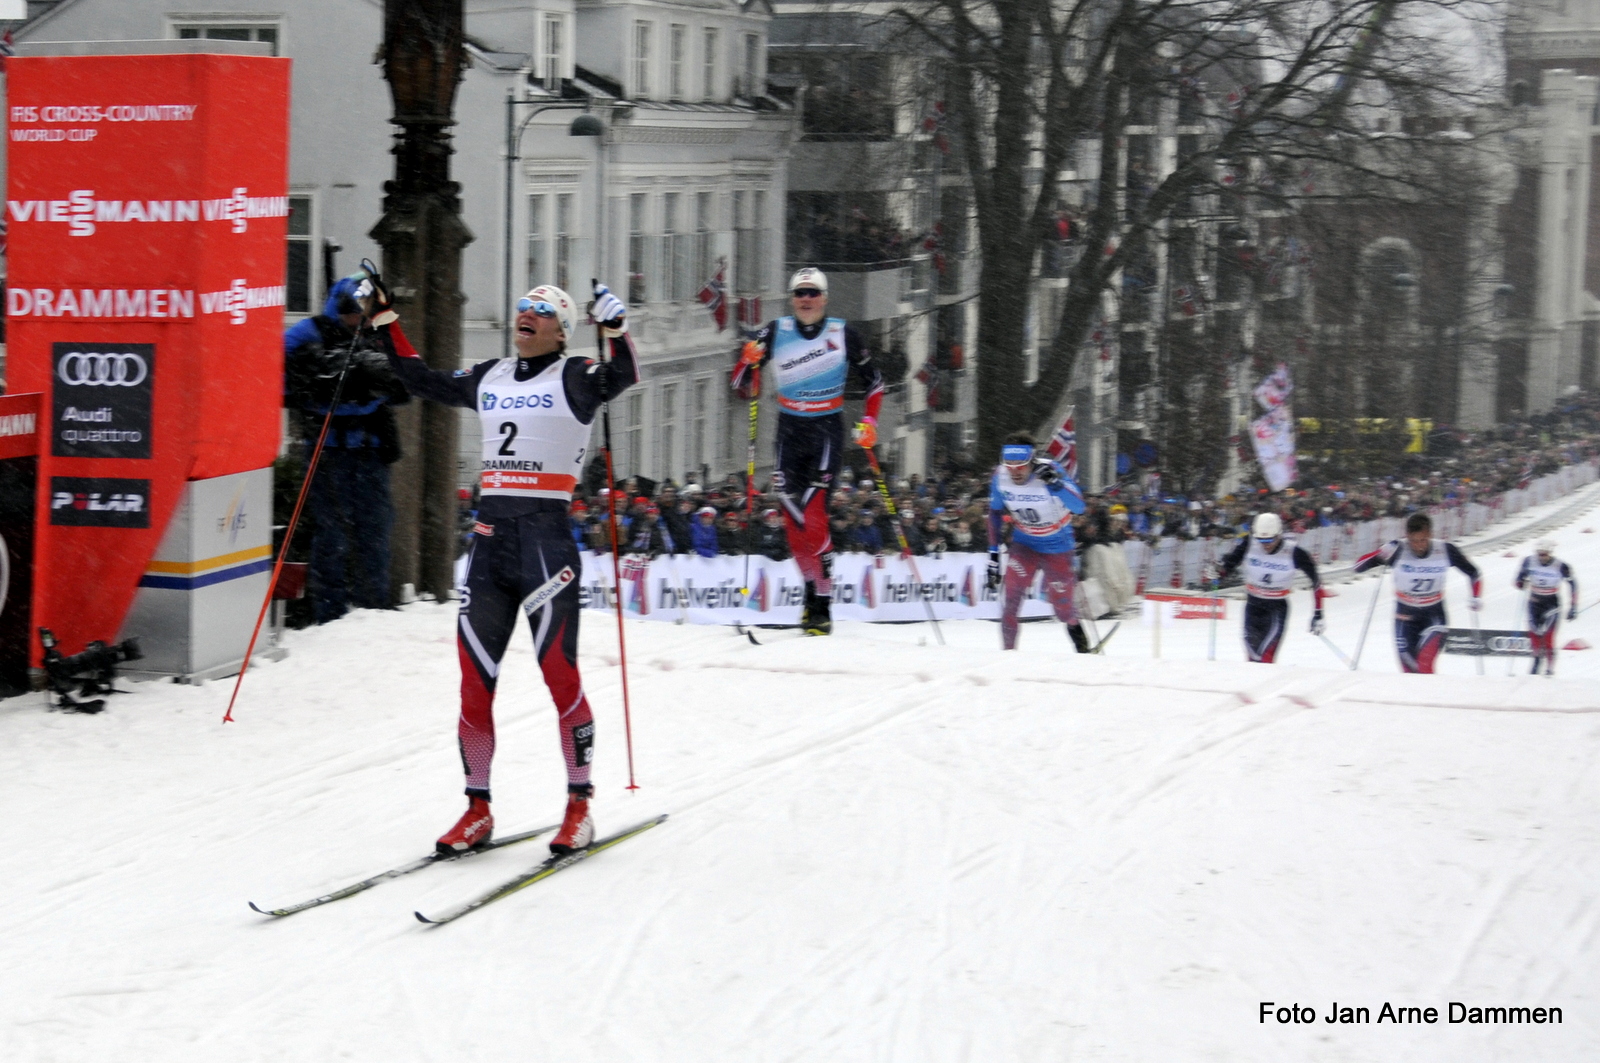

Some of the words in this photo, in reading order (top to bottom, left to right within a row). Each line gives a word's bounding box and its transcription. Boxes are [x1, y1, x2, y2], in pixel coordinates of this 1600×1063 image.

[11, 106, 38, 122] FIS
[41, 105, 196, 122] CROSS-COUNTRY
[11, 129, 65, 141] WORLD
[67, 129, 98, 141] CUP
[8, 189, 199, 236] VIESSMANN
[8, 287, 195, 318] DRAMMEN
[501, 394, 554, 409] OBOS
[61, 406, 112, 422] Audi
[61, 429, 142, 445] quattro
[498, 421, 518, 456] 2
[575, 447, 586, 464] 2
[52, 492, 144, 511] POLAR
[1260, 573, 1272, 585] 4
[1411, 578, 1434, 592] 27
